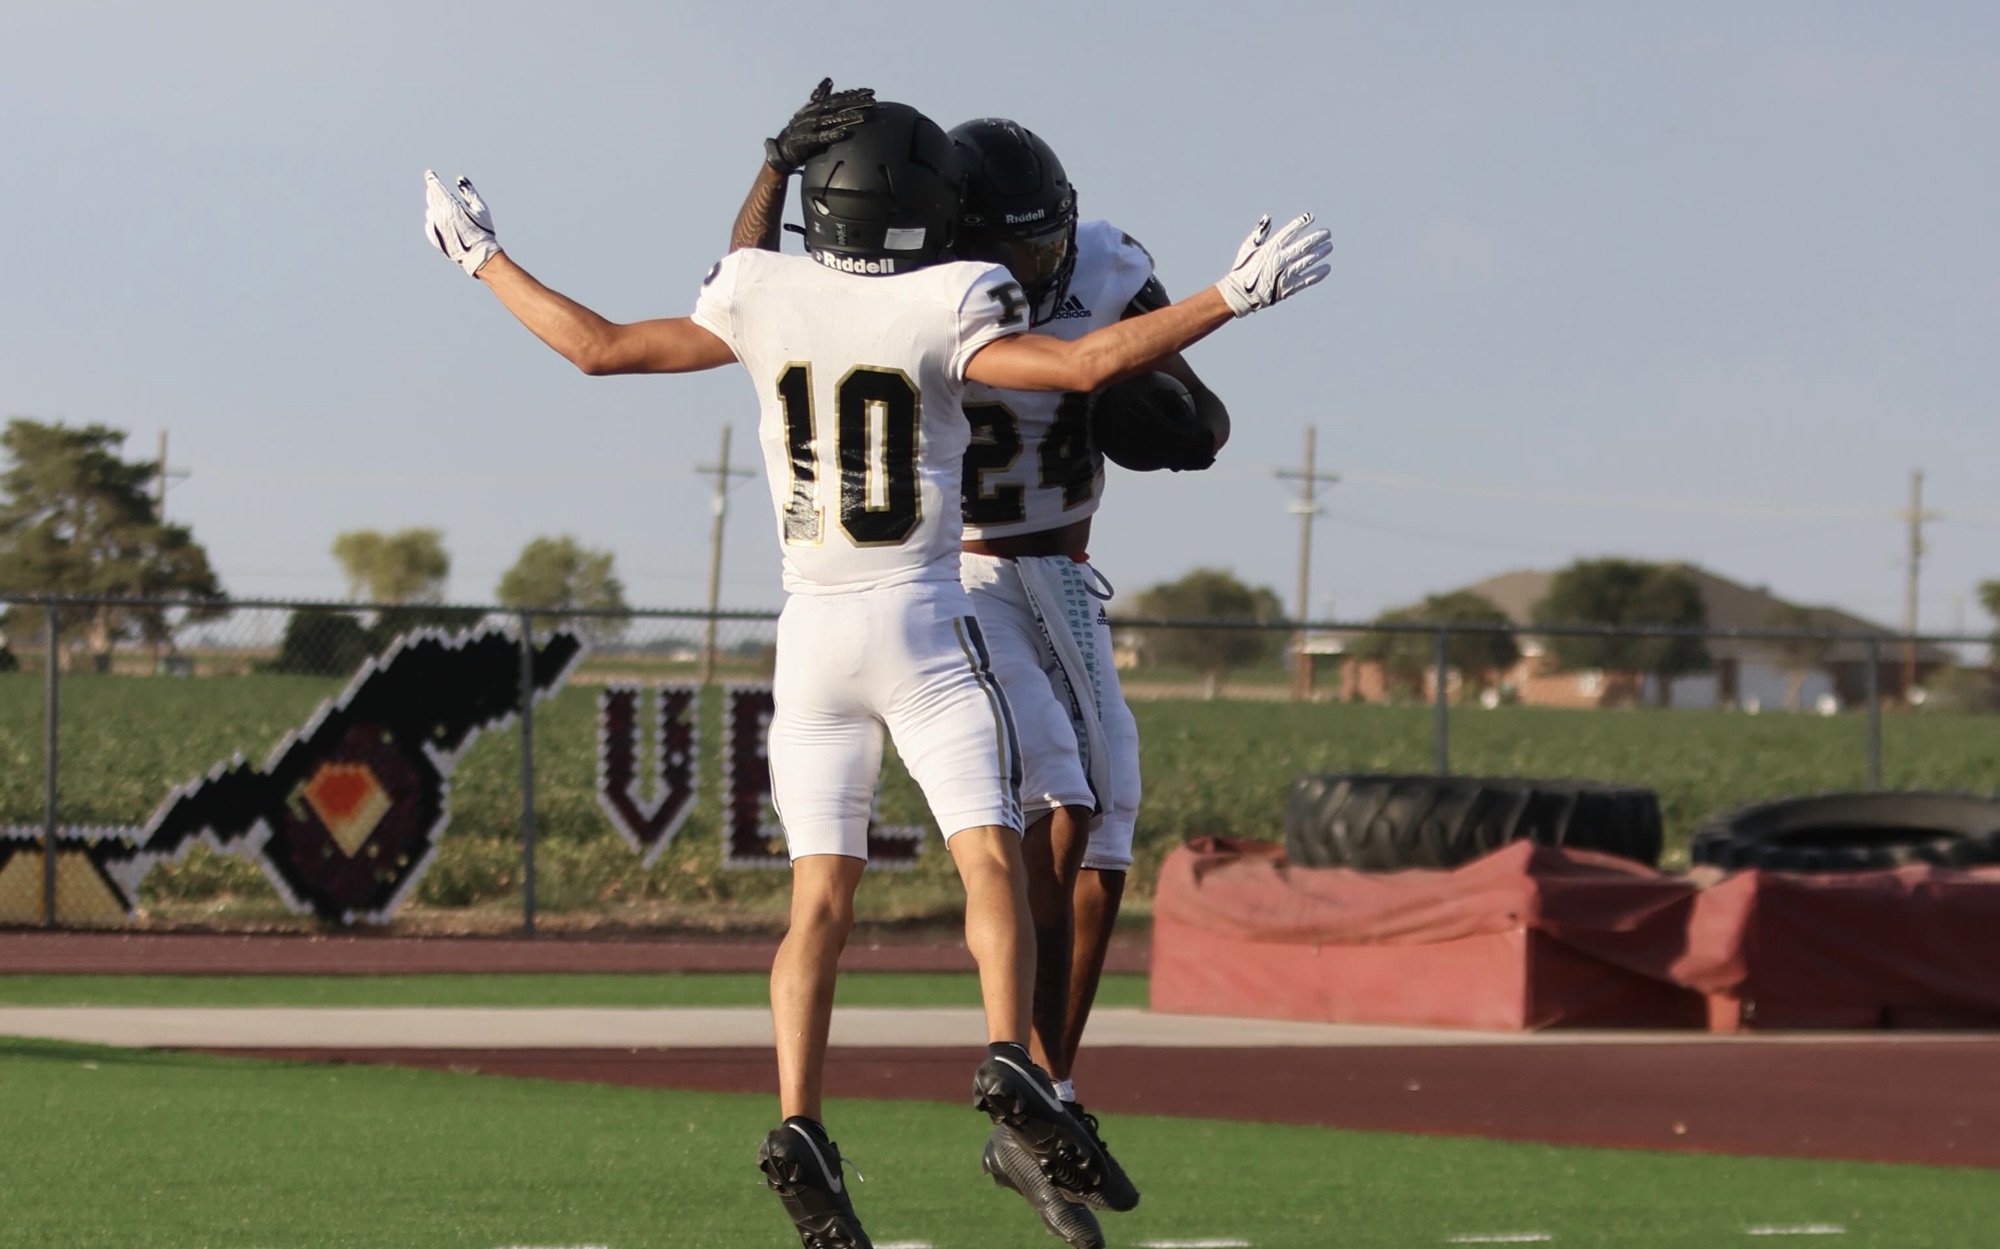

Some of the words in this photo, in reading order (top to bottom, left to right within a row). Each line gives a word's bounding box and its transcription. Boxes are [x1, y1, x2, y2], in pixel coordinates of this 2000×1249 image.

[1006, 208, 1045, 224] Riddell
[823, 250, 895, 274] Riddell
[1054, 309, 1092, 320] adidas
[776, 361, 922, 549] 10
[961, 391, 1096, 526] 24
